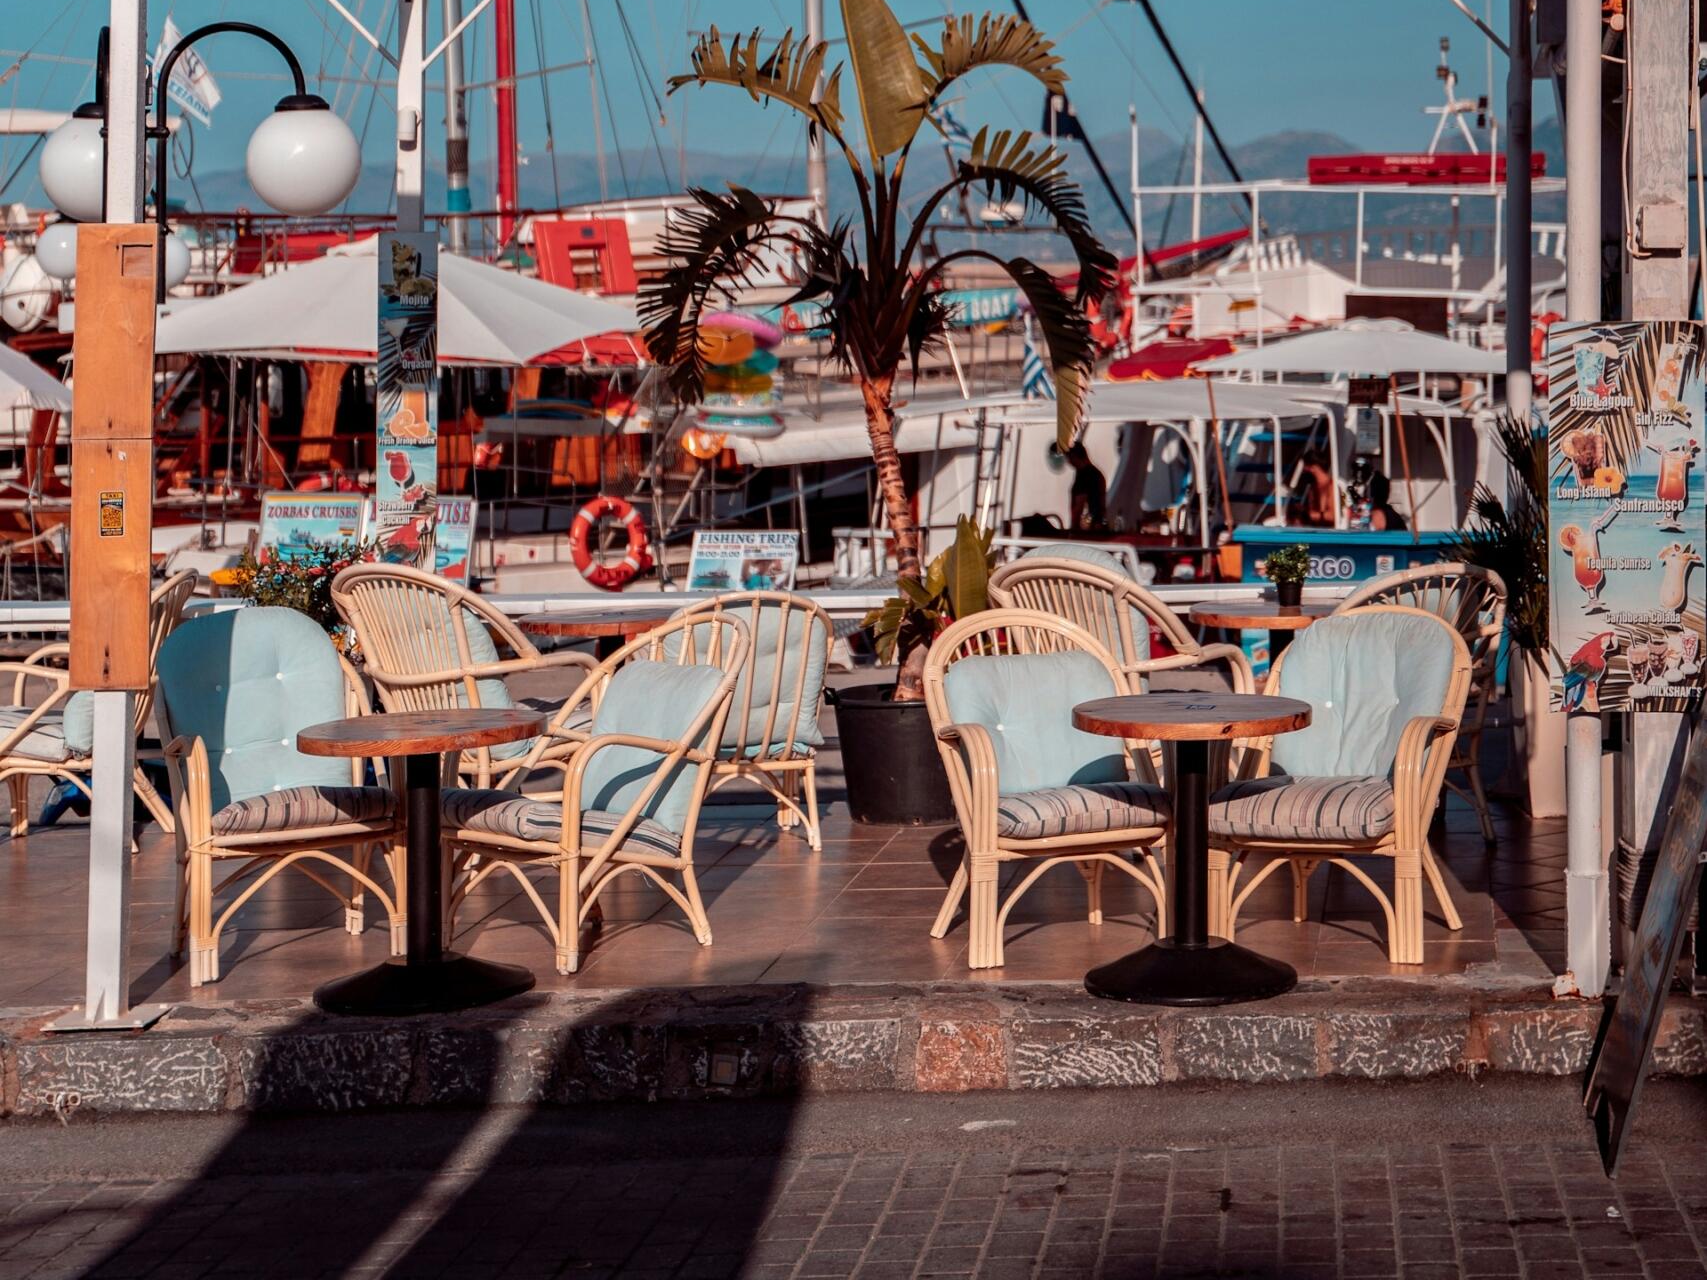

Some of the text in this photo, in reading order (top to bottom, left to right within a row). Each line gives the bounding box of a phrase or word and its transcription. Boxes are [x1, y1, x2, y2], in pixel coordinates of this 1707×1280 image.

[400, 295, 429, 306] Mojito
[971, 296, 1010, 319] BOAT
[402, 359, 432, 370] Orgasm
[1570, 394, 1635, 409] Blue Lagoon
[1635, 411, 1675, 426] Gin Fizz
[378, 436, 435, 446] Fresh Orange Juice
[1556, 486, 1611, 500] Long Island
[267, 506, 310, 519] ZORBAS
[312, 505, 358, 518] CRUISES
[379, 502, 414, 513] Strawberry
[435, 503, 470, 524] UISE
[383, 515, 410, 525] Cocktail
[700, 533, 797, 544] FISHING TRIPS
[1307, 556, 1354, 578] RGO
[1587, 557, 1652, 570] Tequila Sunrise
[1605, 612, 1681, 624] Caribbean Colada
